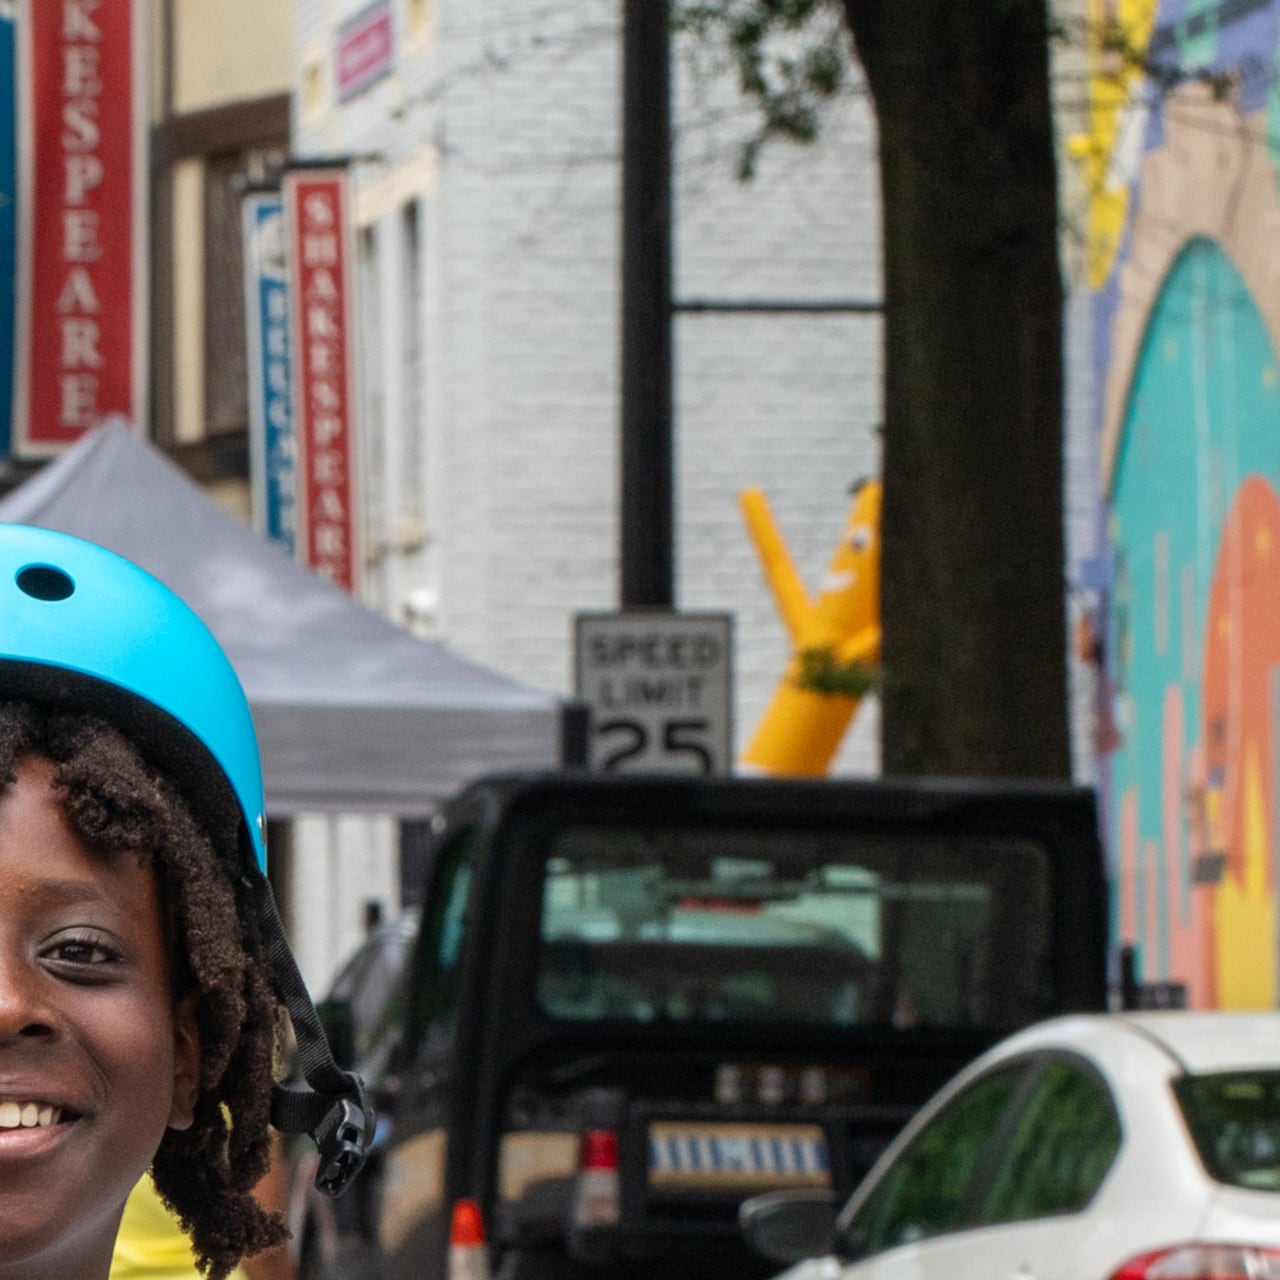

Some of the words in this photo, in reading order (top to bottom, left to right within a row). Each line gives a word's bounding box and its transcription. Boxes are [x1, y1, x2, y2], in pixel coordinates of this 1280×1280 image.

[590, 633, 722, 670] SPEED
[597, 674, 708, 708] LIMIT
[596, 716, 714, 776] 25
